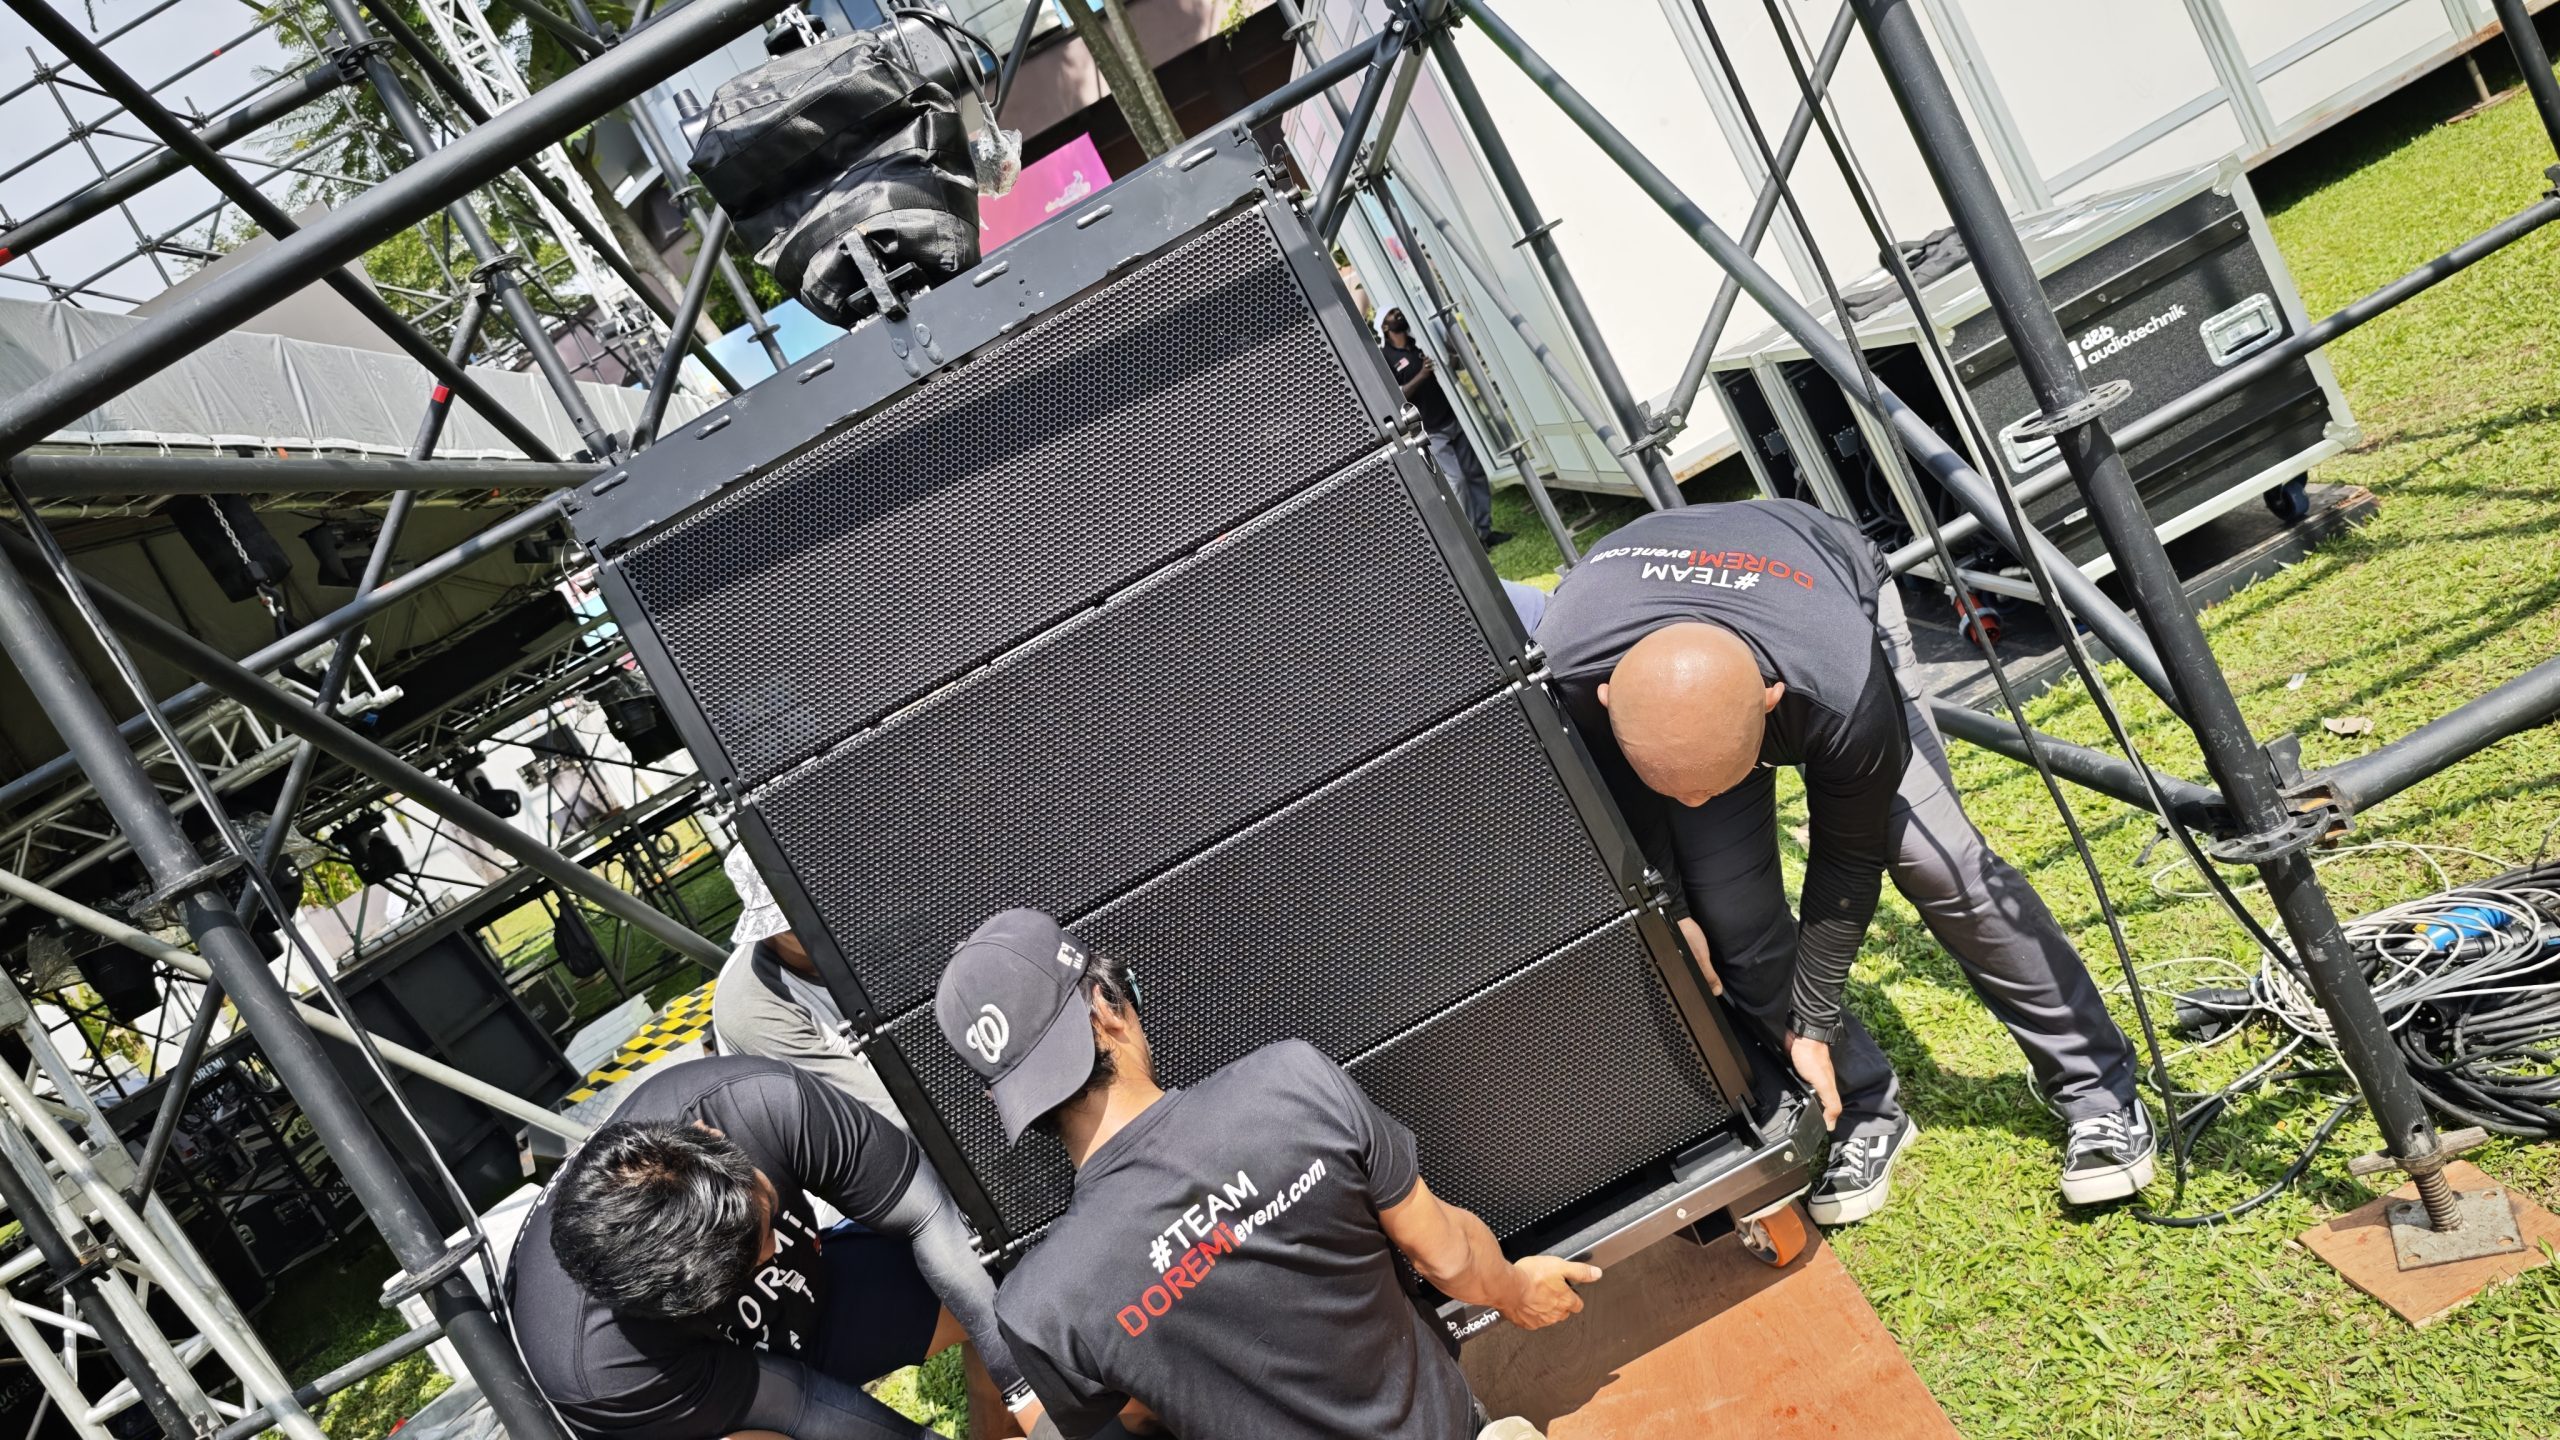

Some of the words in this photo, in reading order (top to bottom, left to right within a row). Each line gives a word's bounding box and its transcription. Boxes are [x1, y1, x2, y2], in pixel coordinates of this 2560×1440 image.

[2081, 325, 2115, 350] d&b
[2088, 304, 2187, 364] audiotechnik
[1641, 561, 1760, 591] #TEAM
[191, 1056, 226, 1085] OREMi
[1149, 1170, 1259, 1274] #TEAM
[1453, 1310, 1501, 1340] diotechn
